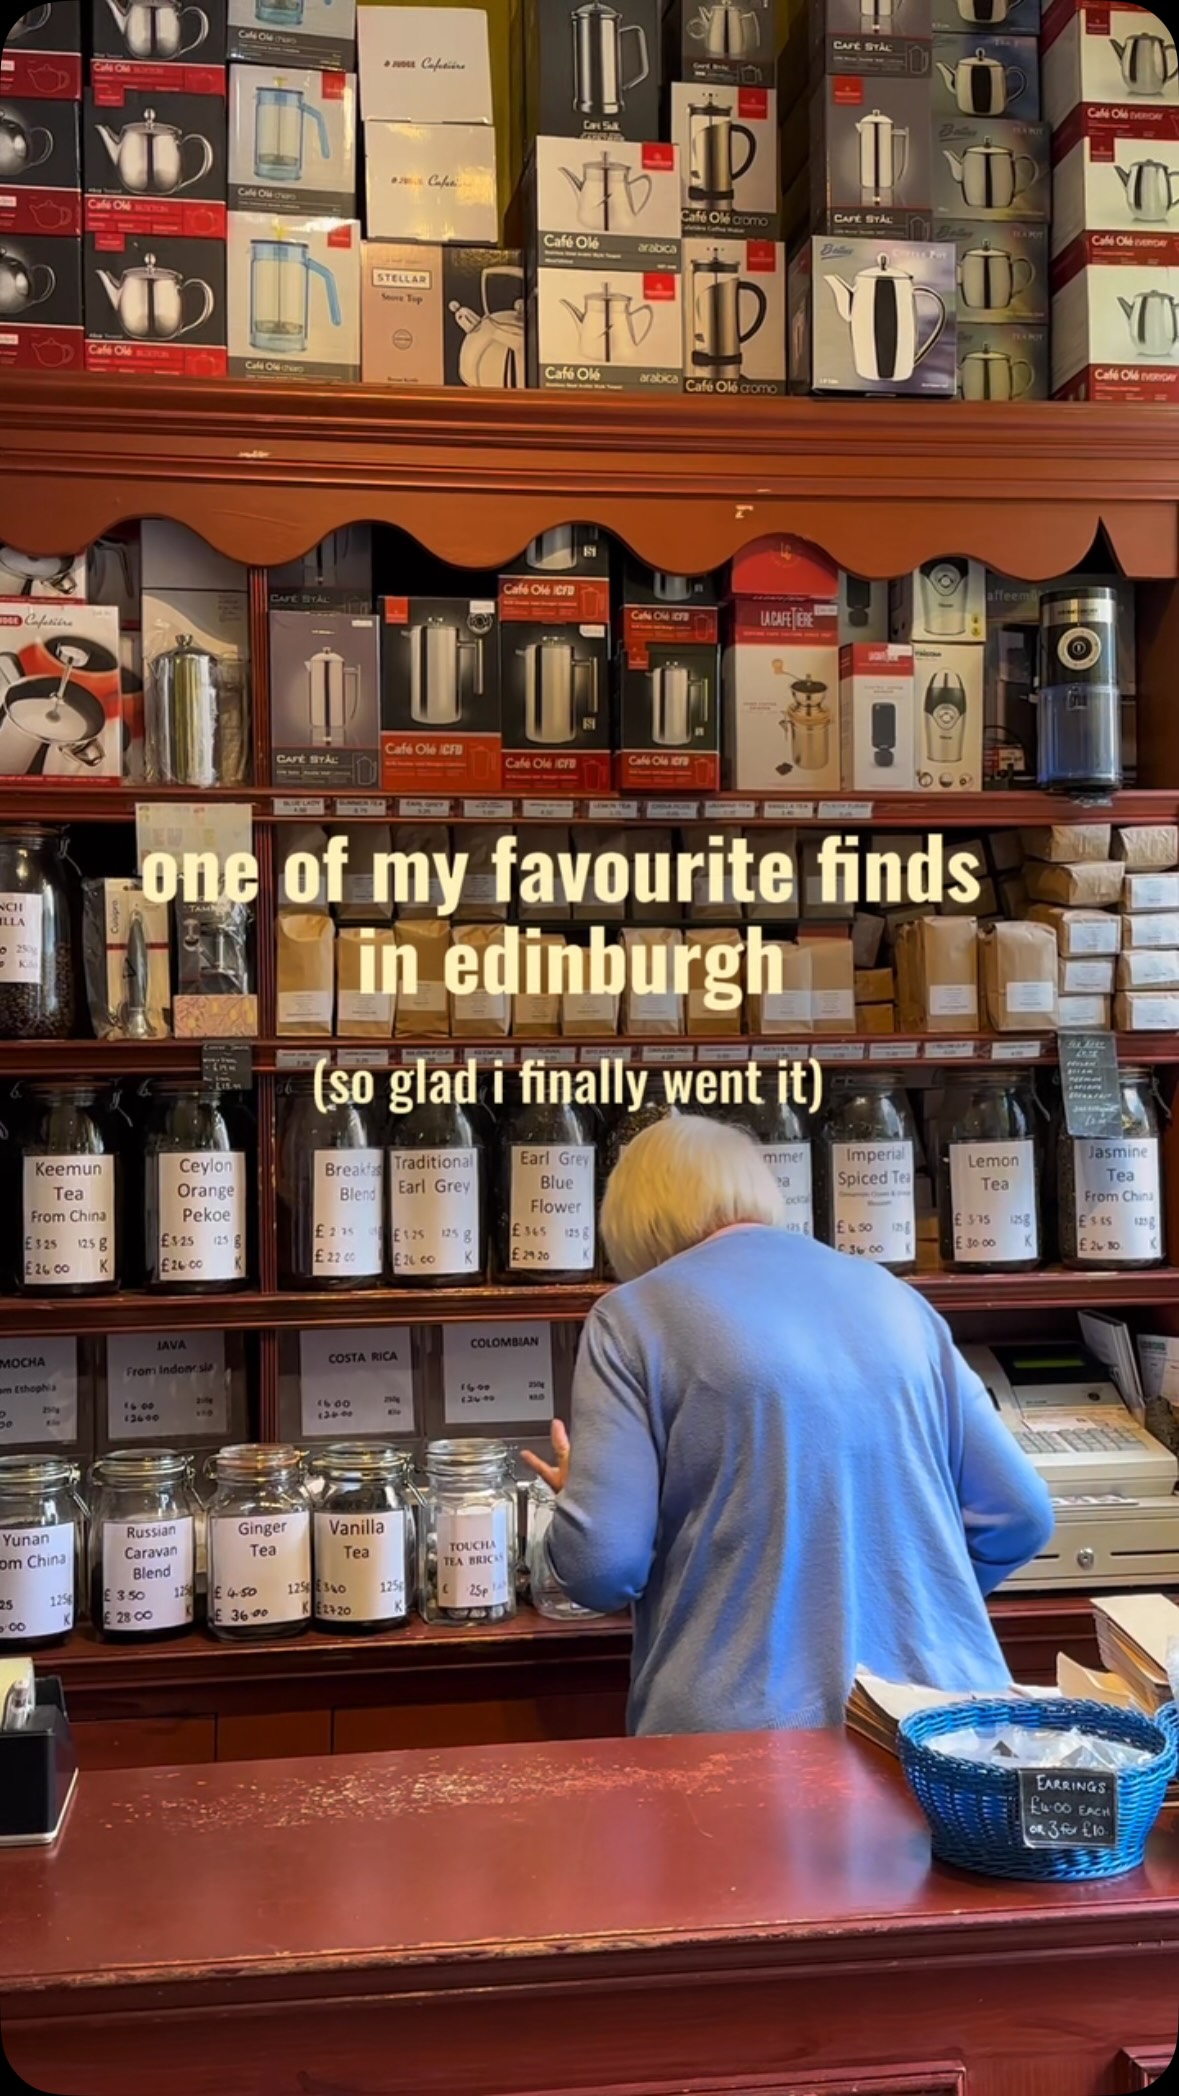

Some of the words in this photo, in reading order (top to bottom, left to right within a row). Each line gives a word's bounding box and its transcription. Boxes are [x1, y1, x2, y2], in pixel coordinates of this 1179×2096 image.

[1087, 107, 1110, 119] Café
[680, 210, 707, 223] Café
[709, 212, 730, 224] Olé
[733, 216, 768, 227] cromo
[544, 234, 574, 248] Café
[576, 236, 600, 250] Olé
[638, 243, 677, 254] arabica
[1092, 235, 1114, 246] Café
[377, 273, 427, 284] STELLAR
[545, 366, 575, 381] Café
[577, 368, 600, 382] Olé
[640, 372, 678, 384] arabica
[1094, 368, 1119, 380] Café
[1121, 369, 1140, 380] Olé
[685, 380, 714, 394] Café
[716, 381, 738, 394] Olé
[740, 384, 778, 394] cromo
[504, 582, 529, 596] Café
[530, 584, 551, 596] Olé
[385, 744, 414, 756] Café
[416, 743, 437, 756] Olé
[505, 758, 532, 770] Café
[533, 758, 552, 770] Olé
[520, 1151, 550, 1165] Earl
[559, 1152, 590, 1168] Grey
[847, 1148, 906, 1165] Imperial
[1088, 1145, 1149, 1160] Jasmine
[180, 1158, 232, 1176] Ceylon
[394, 1155, 474, 1170] Traditional
[968, 1154, 1020, 1168] Lemon
[35, 1162, 102, 1176] Keemun
[1106, 1168, 1134, 1182] Tea
[540, 1175, 574, 1190] Blue
[838, 1171, 888, 1187] Spiced
[892, 1170, 911, 1185] Tea
[981, 1177, 1010, 1192] Tea
[54, 1186, 84, 1201] Tea
[178, 1183, 235, 1200] Orange
[340, 1186, 376, 1202] Blend
[399, 1179, 426, 1194] Earl
[435, 1180, 471, 1197] Grey
[1084, 1190, 1118, 1202] From
[1122, 1190, 1154, 1202] China
[530, 1198, 582, 1214] Flower
[31, 1210, 66, 1223] From
[70, 1210, 107, 1223] China
[183, 1208, 230, 1223] Pekoe
[1024, 1235, 1032, 1248] K
[465, 1250, 473, 1264] K
[582, 1248, 590, 1260] K
[100, 1258, 108, 1273] K
[234, 1256, 241, 1270] K
[157, 1340, 187, 1351] JAVA
[470, 1336, 539, 1348] COLOMBIAN
[0, 1356, 46, 1369] MOCHA
[328, 1352, 366, 1364] COSTA
[371, 1350, 398, 1362] RICA
[126, 1366, 156, 1376] From
[127, 1526, 176, 1538] Russian
[238, 1520, 288, 1537] Ginger
[329, 1518, 384, 1536] Vanilla
[3, 1534, 50, 1546] Yunan
[450, 1541, 496, 1552] TOUCHA
[124, 1545, 178, 1560] Caravan
[250, 1544, 277, 1558] Tea
[344, 1545, 370, 1559] Tea
[27, 1554, 66, 1570] China
[444, 1556, 463, 1566] TEA
[133, 1566, 172, 1580] Blend
[302, 1602, 310, 1614] K
[394, 1600, 402, 1612] K
[63, 1614, 71, 1626] K
[1036, 1774, 1106, 1794] EARRINGS
[1079, 1806, 1110, 1817] EACH
[1029, 1825, 1046, 1836] OR
[1048, 1821, 1060, 1840] 3
